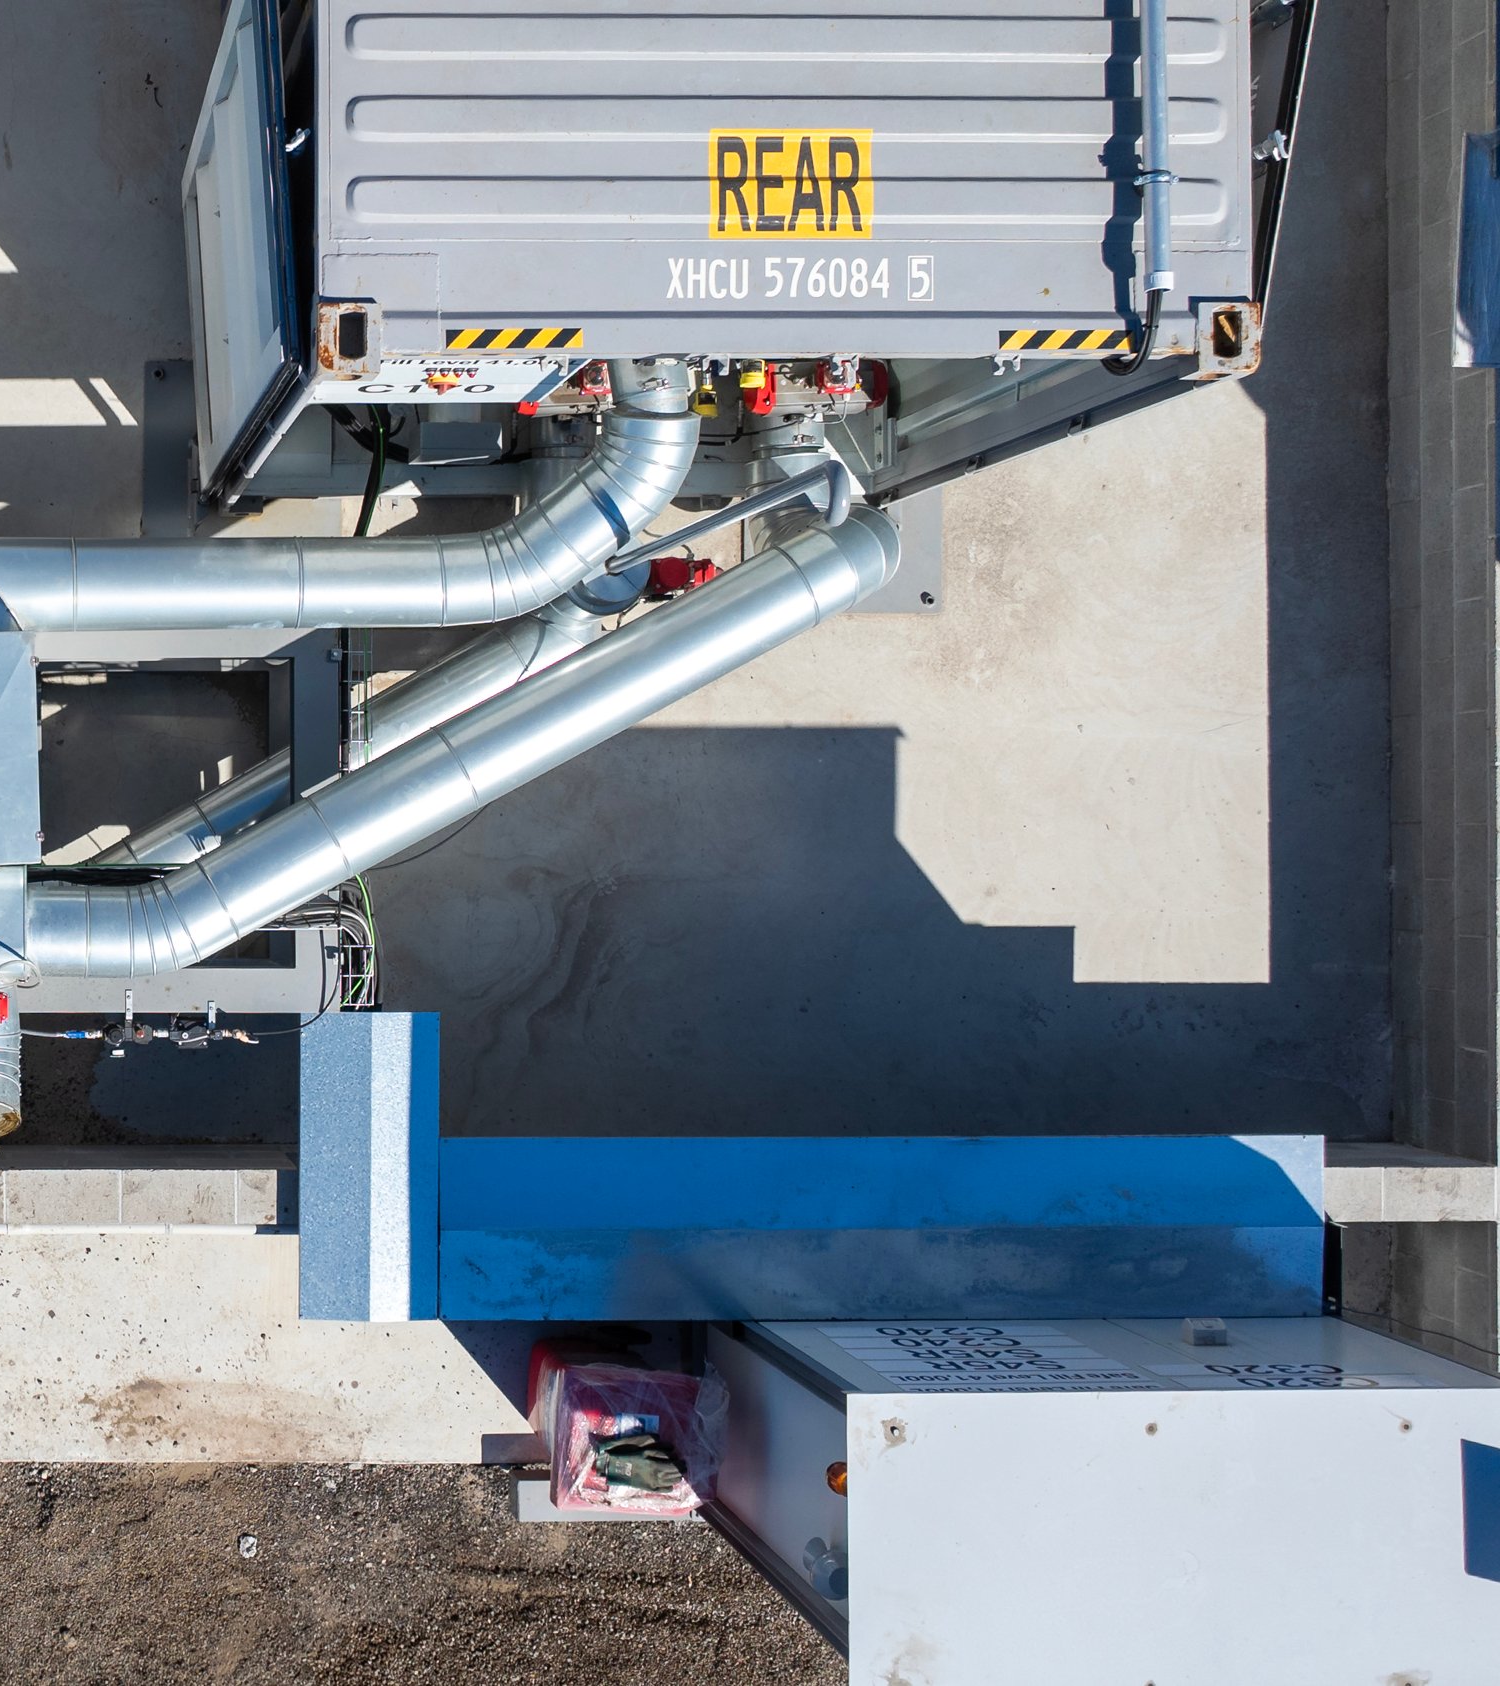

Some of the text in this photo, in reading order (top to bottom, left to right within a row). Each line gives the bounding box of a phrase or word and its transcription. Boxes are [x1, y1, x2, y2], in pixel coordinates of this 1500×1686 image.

[717, 136, 863, 231] REAR
[666, 257, 930, 299] XHCU 576084 5
[358, 384, 495, 394] C10
[876, 1326, 1004, 1336] C240
[891, 1337, 1022, 1348] C240
[902, 1348, 1043, 1359] S45R
[923, 1360, 1066, 1371] S45R
[1204, 1364, 1345, 1375] C320
[1237, 1377, 1380, 1388] C320
